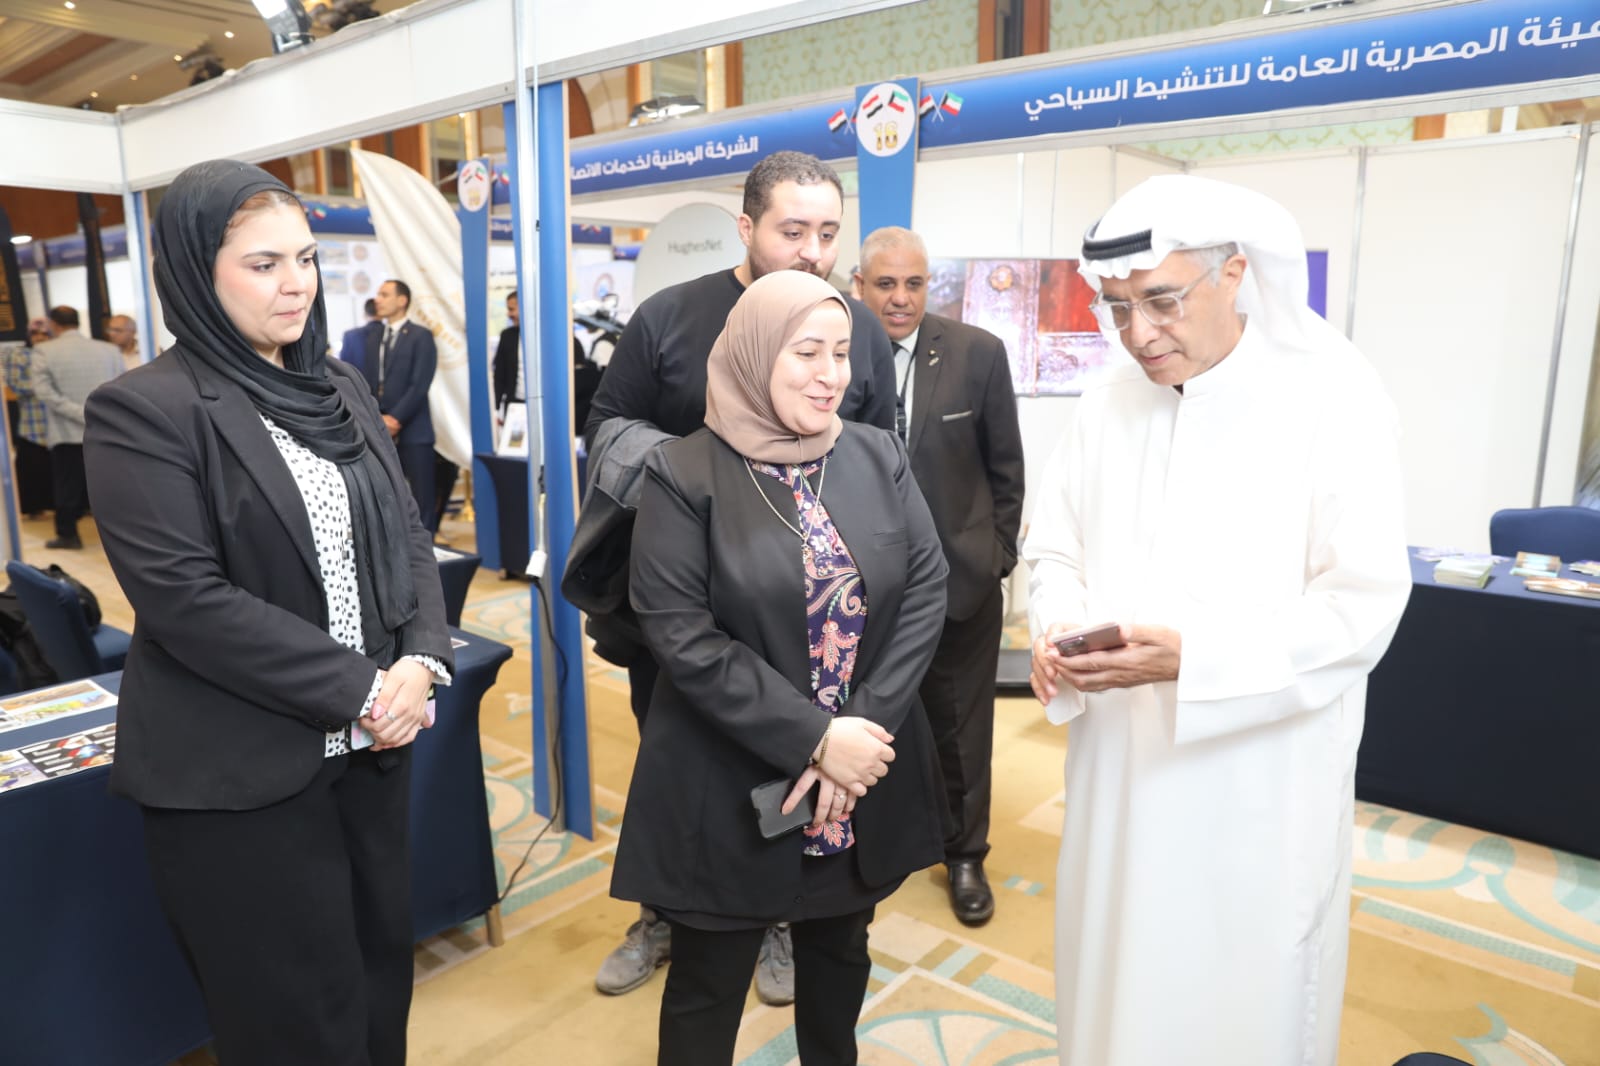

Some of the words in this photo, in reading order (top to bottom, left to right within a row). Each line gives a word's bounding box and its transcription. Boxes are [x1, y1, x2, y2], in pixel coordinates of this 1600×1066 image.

[1366, 26, 1509, 73] المصرية
[1256, 48, 1358, 83] العامة
[1133, 62, 1251, 100] للتنشيط
[1024, 79, 1128, 121] السياحي
[652, 145, 703, 170] الوطنية
[705, 135, 759, 160] الشركة
[571, 161, 602, 180] الاتصا
[602, 153, 651, 176] لخدمات
